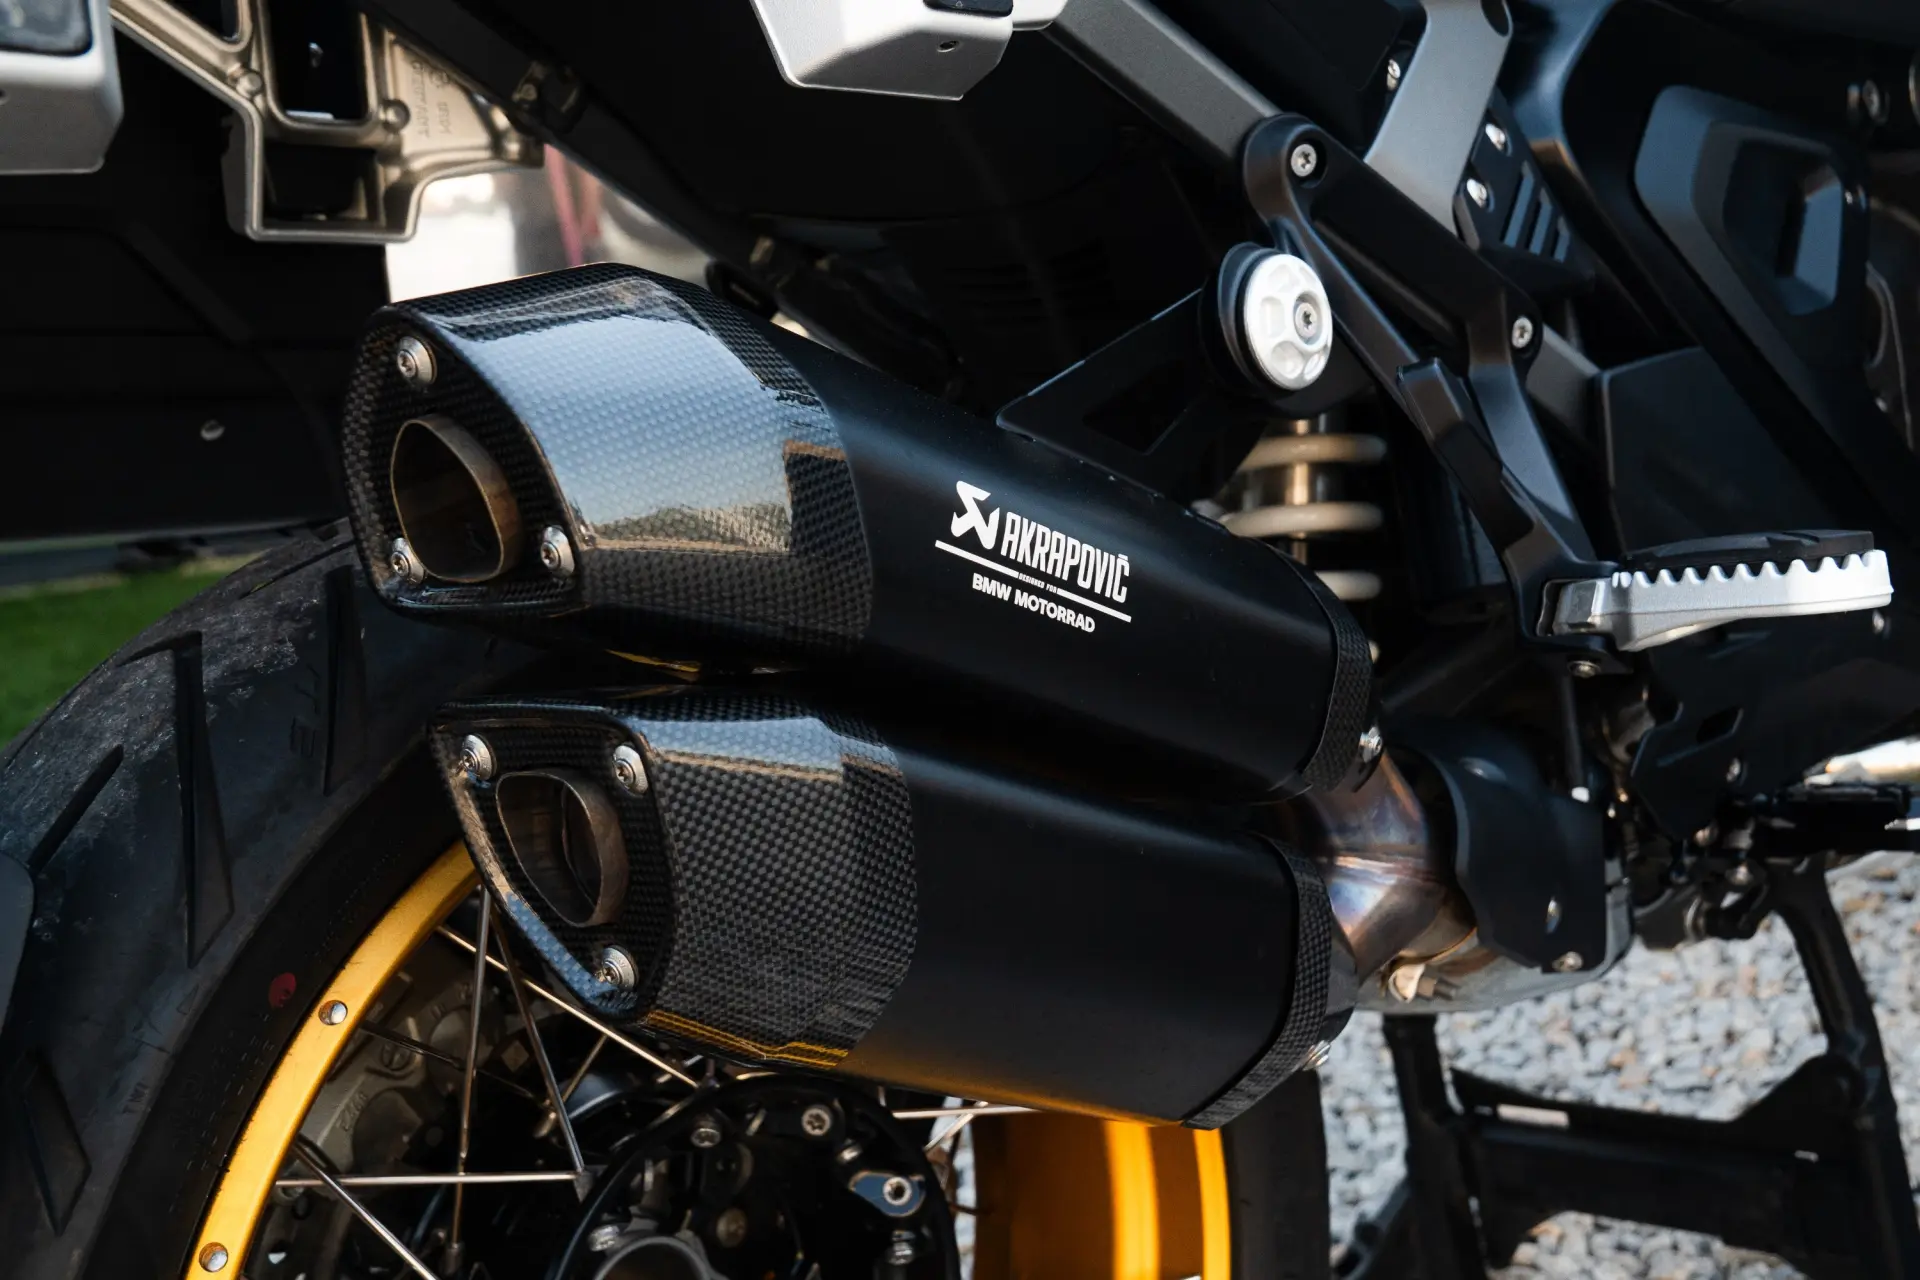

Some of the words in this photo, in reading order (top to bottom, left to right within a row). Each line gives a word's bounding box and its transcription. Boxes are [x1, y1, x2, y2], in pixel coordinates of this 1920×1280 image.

[972, 573, 1012, 602] BMW
[1014, 589, 1096, 633] MOTORRAD
[1018, 572, 1045, 589] DESIGNED
[1046, 583, 1058, 594] FOR
